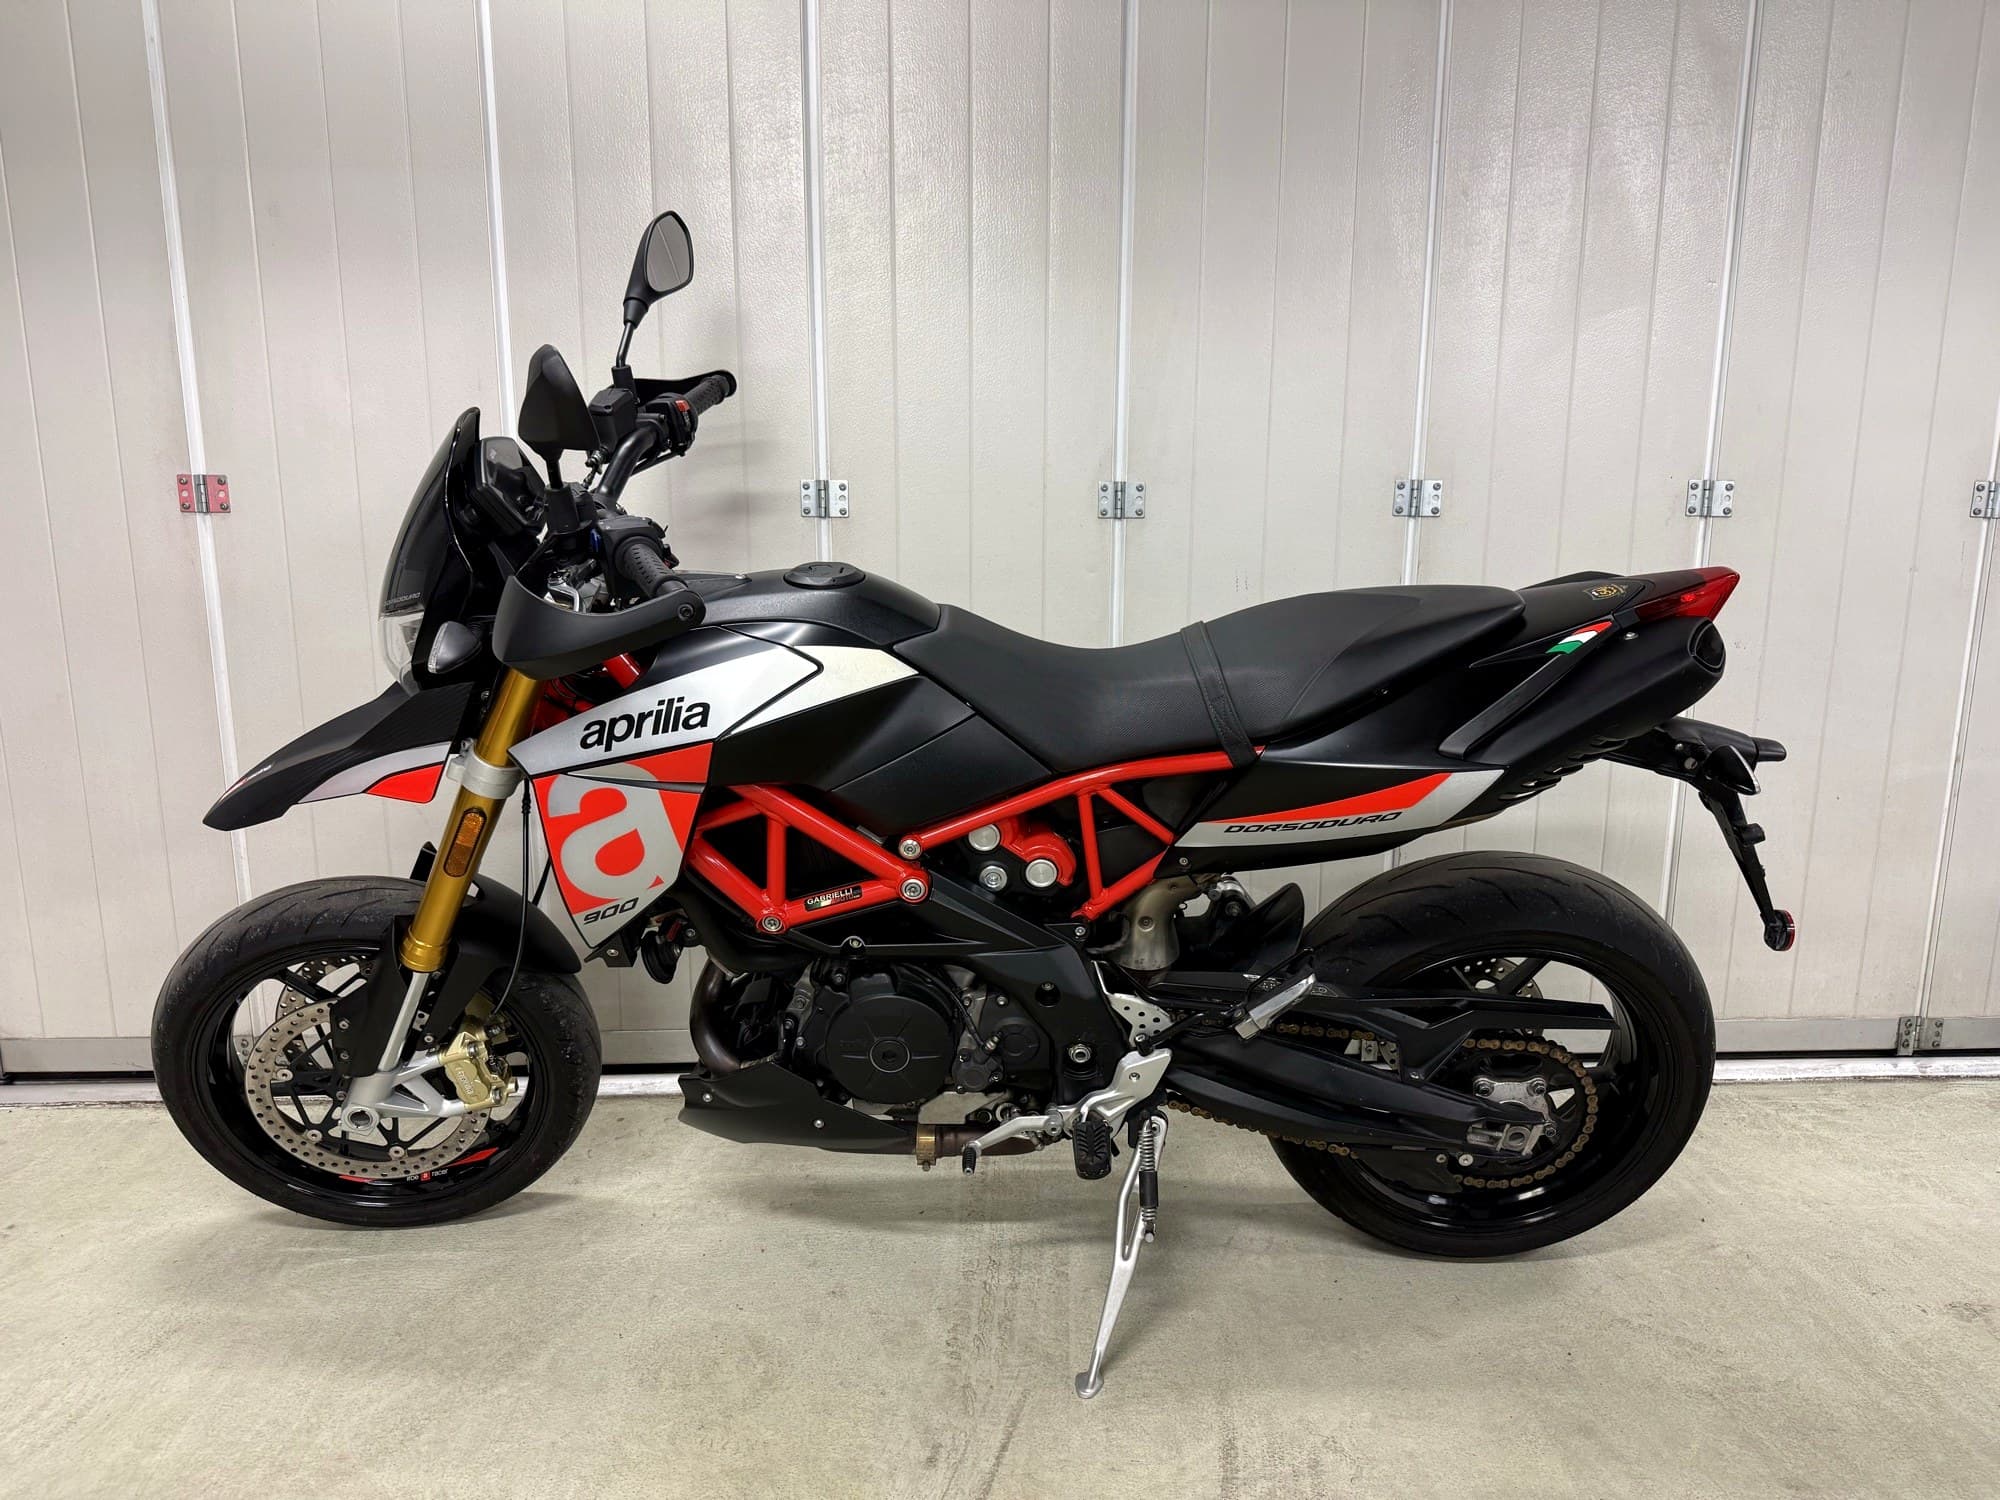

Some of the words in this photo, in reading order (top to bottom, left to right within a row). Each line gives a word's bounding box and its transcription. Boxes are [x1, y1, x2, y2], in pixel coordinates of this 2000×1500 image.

[580, 696, 711, 752] aprilia
[1224, 811, 1402, 833] DORSODURO
[807, 888, 853, 905] GABRIELLI
[583, 897, 639, 925] 900
